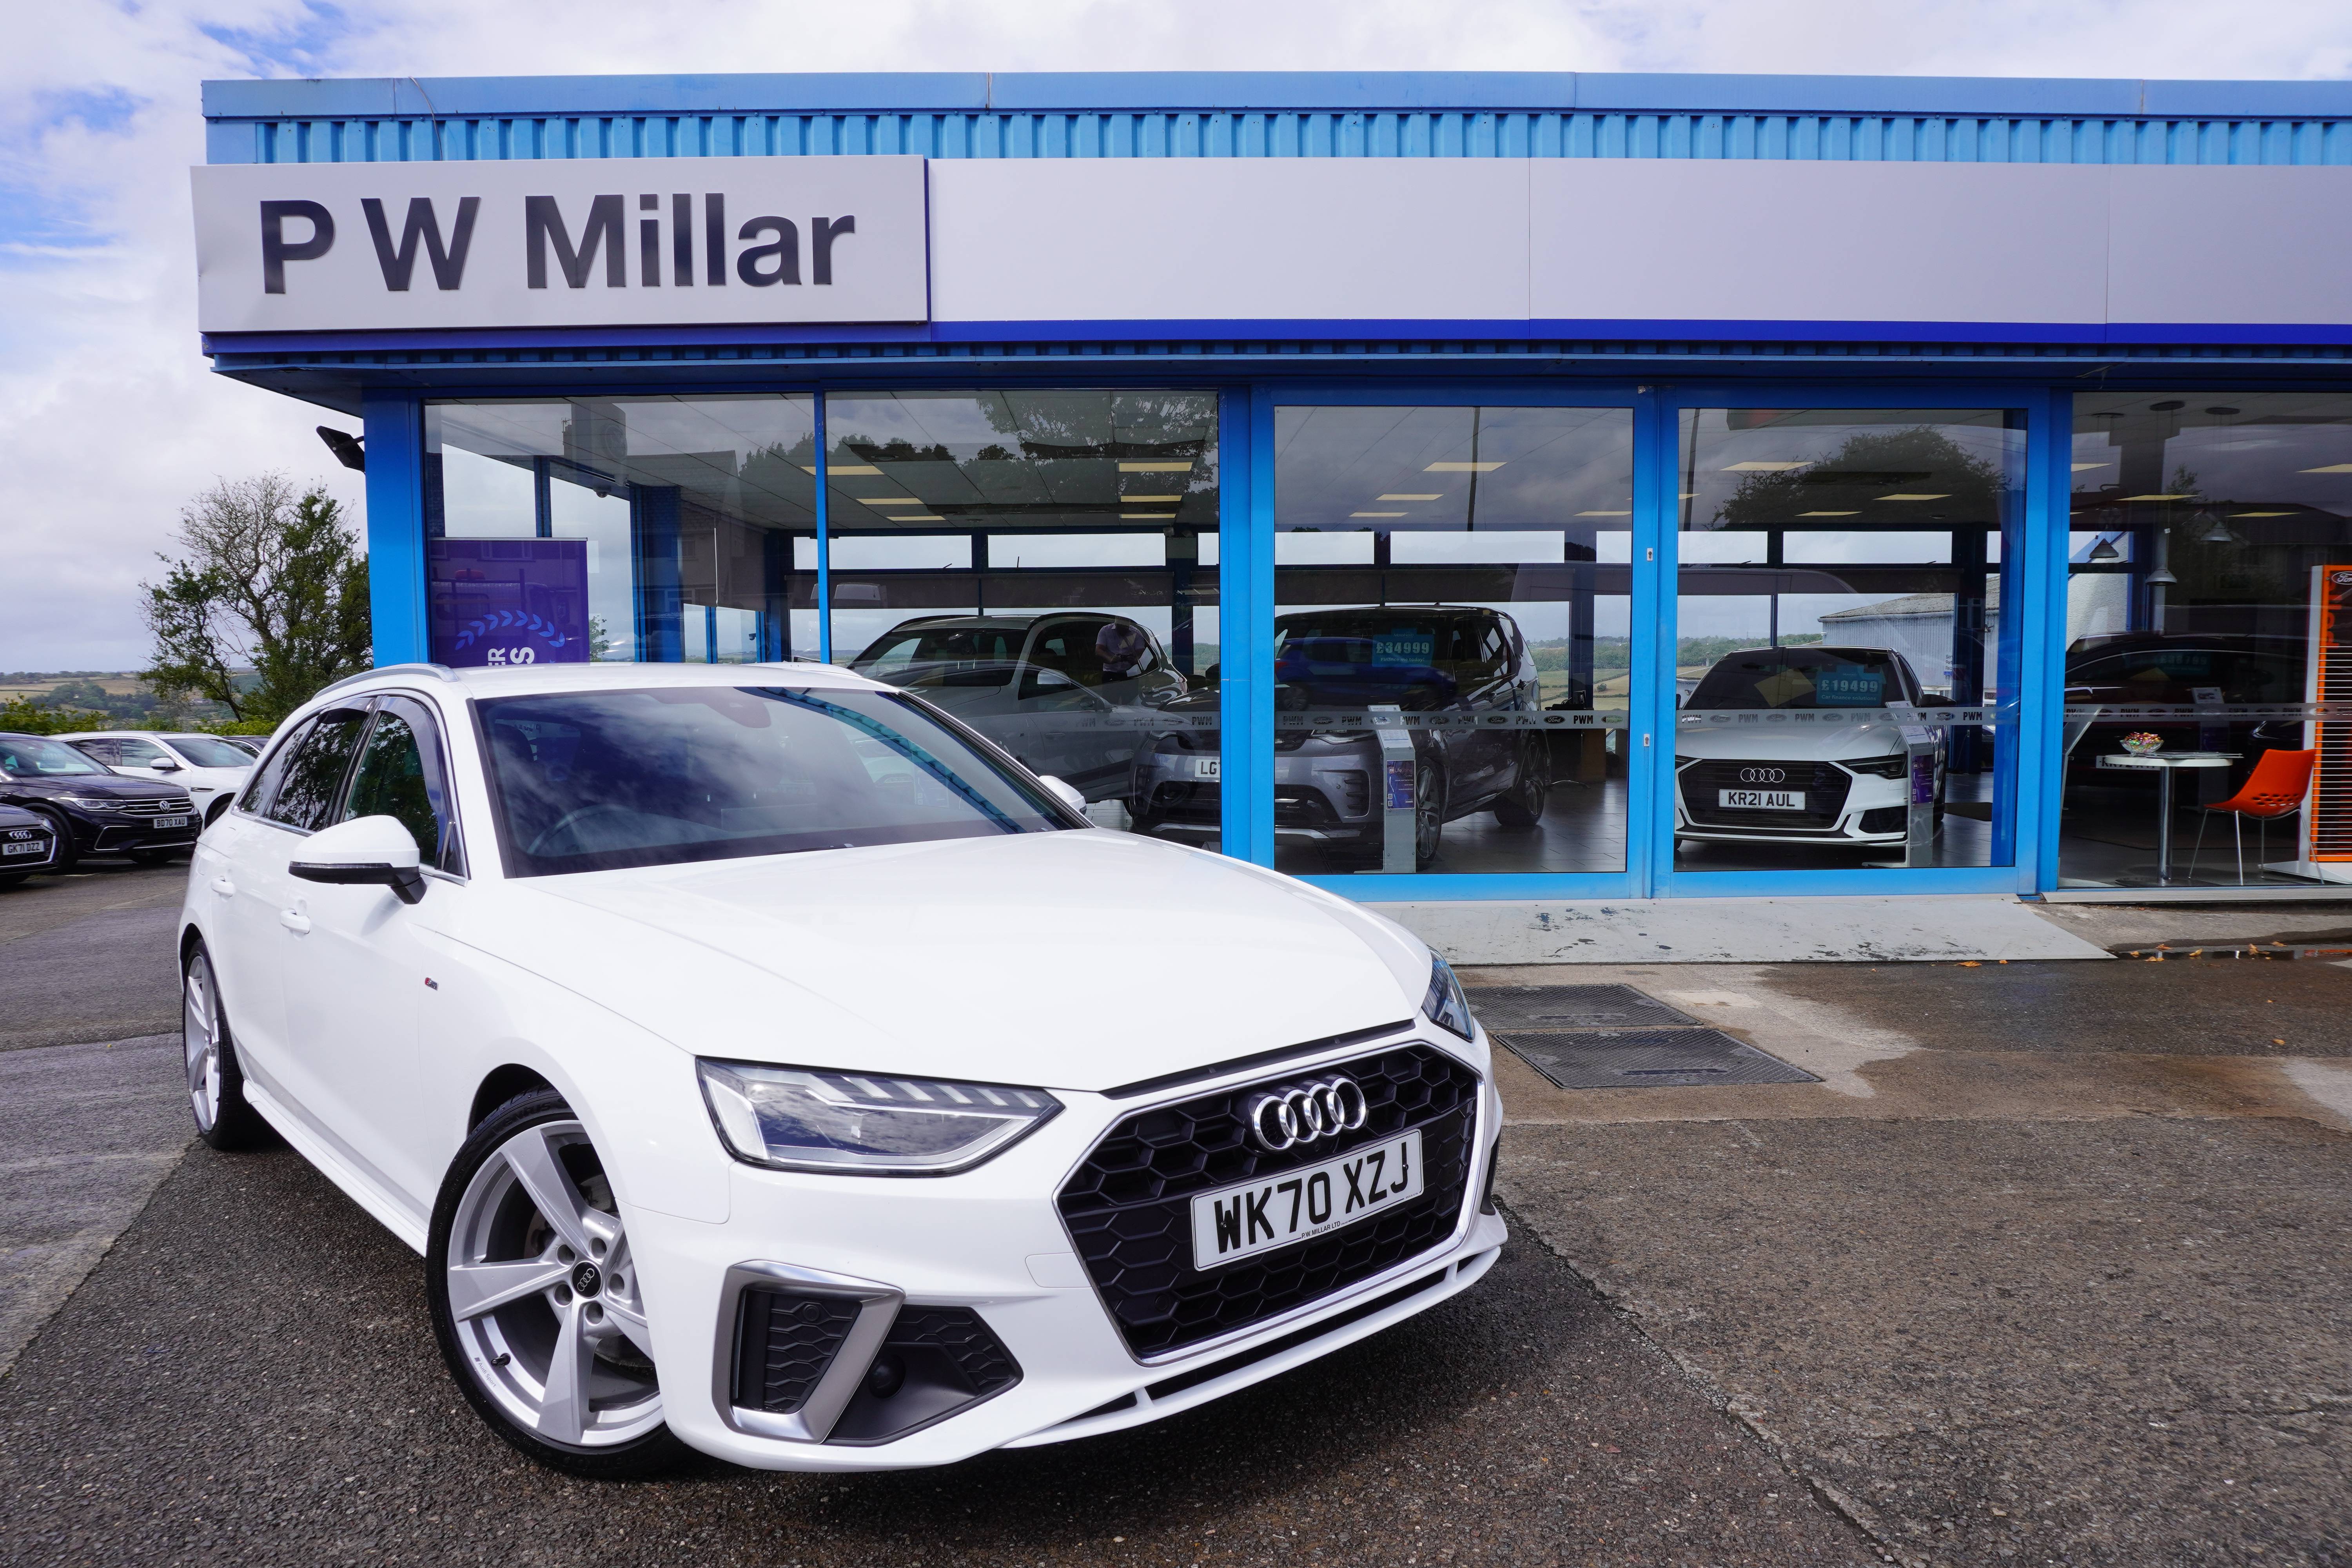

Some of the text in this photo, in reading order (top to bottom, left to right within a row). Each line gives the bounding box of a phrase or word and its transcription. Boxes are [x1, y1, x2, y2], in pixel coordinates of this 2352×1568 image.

[260, 192, 856, 294] P W Millar
[1376, 642, 1430, 653] £34999
[1822, 680, 1878, 693] £19499
[1134, 717, 1154, 726] PWM
[1192, 717, 1212, 725] PWM
[1342, 716, 1362, 725] PWM
[1400, 716, 1420, 725] PWM
[1573, 715, 1593, 724] PWM
[1738, 714, 1758, 723] PWM
[1795, 713, 1815, 722] PWM
[1851, 713, 1871, 722] PWM
[1963, 711, 1982, 720] PWM
[1201, 761, 1220, 775] LG
[1728, 792, 1795, 807] KR21 AUL
[156, 819, 173, 827] BD70
[8, 844, 25, 853] GK71
[1214, 1142, 1407, 1254] WK70 XZJ
[478, 1363, 496, 1387] Audi Sport
